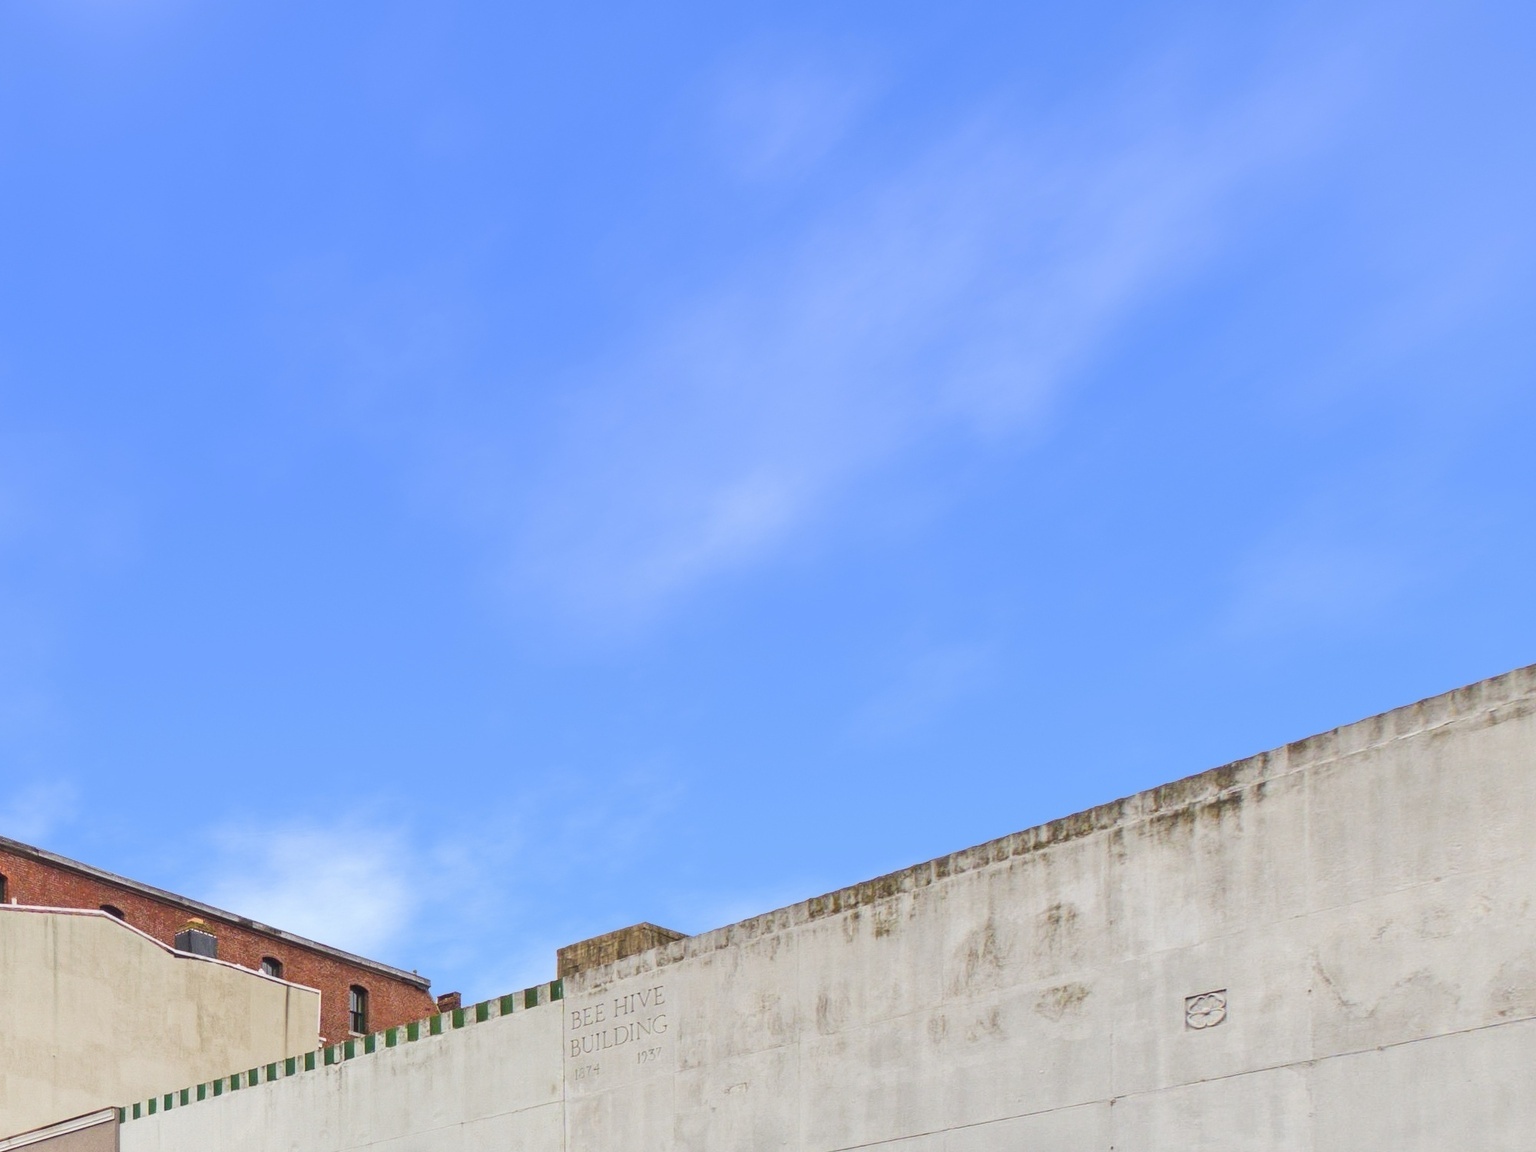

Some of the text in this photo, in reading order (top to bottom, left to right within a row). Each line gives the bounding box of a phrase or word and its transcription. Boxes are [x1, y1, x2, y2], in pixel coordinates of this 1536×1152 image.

[571, 985, 665, 1030] BEE HIVE
[570, 1014, 668, 1058] BUILDING
[637, 1047, 662, 1064] 1937
